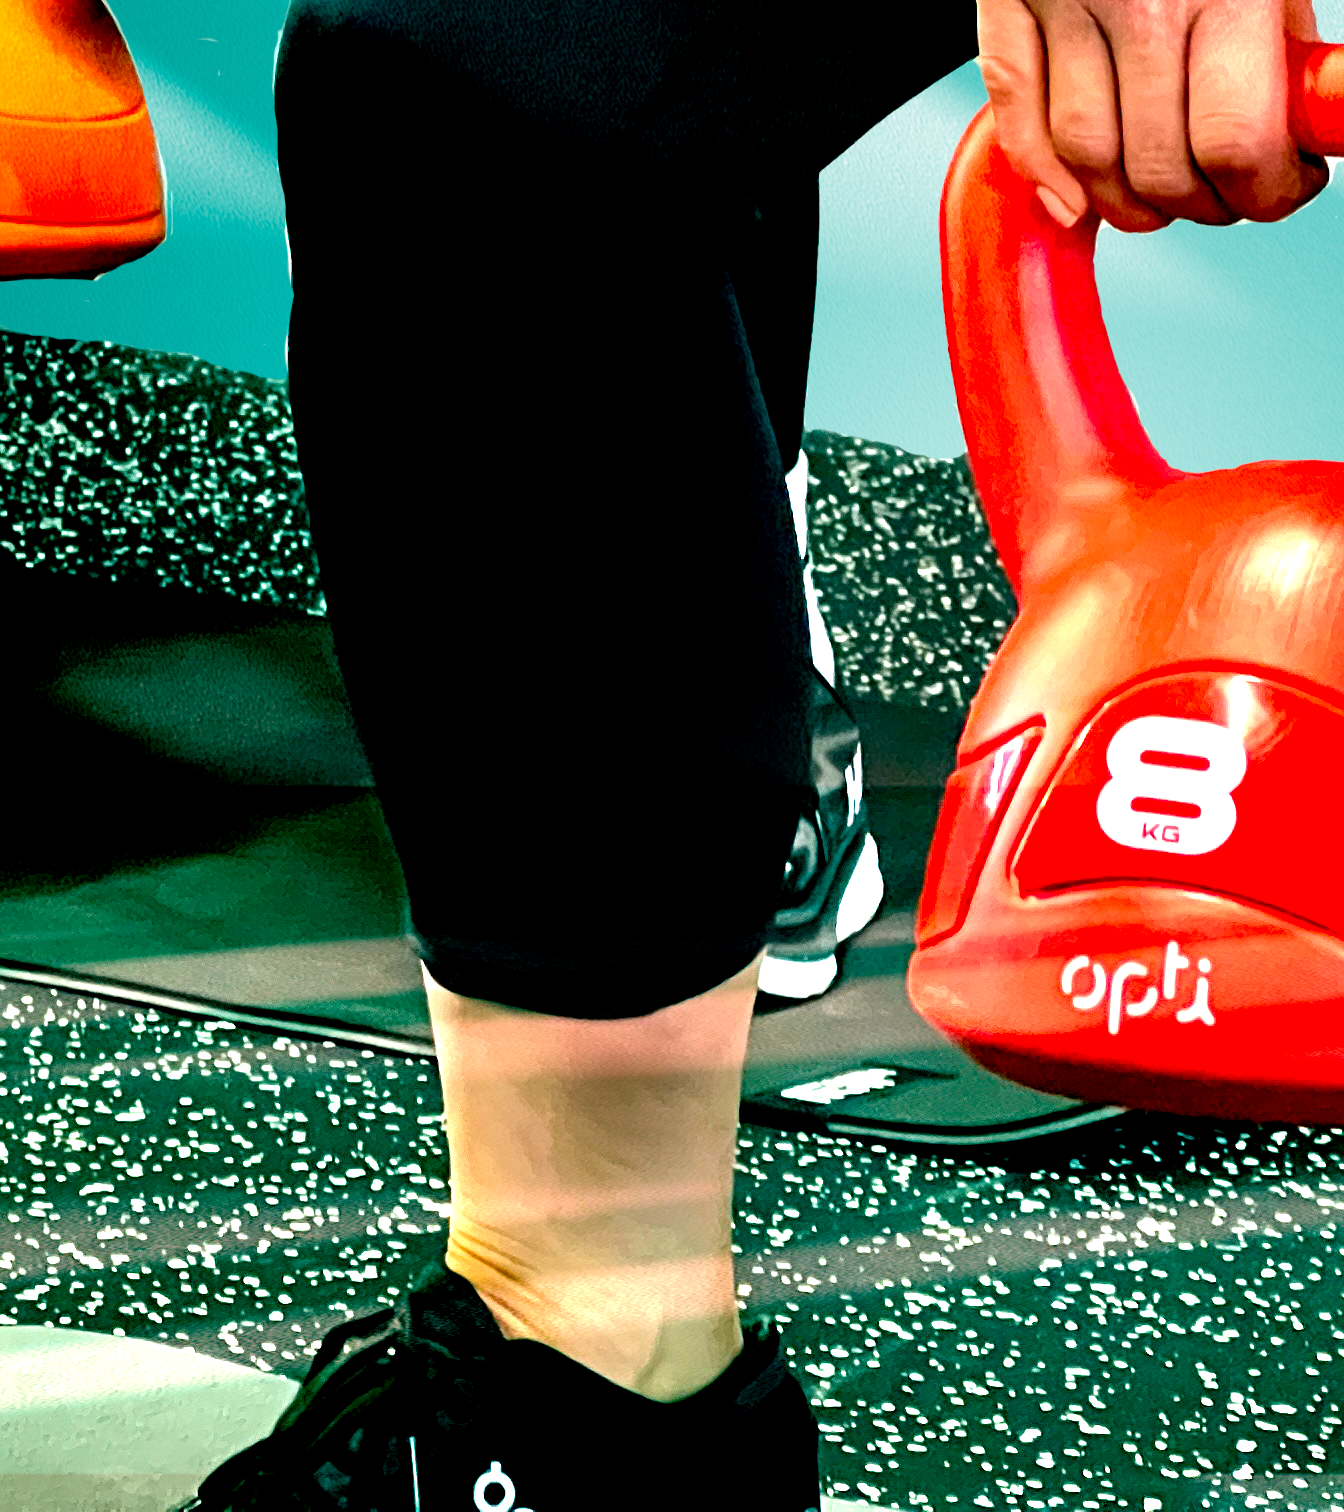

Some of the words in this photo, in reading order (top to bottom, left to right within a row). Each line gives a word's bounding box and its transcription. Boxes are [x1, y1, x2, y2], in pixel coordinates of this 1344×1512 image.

[1096, 714, 1248, 856] 8
[1141, 822, 1181, 844] KG
[1061, 940, 1216, 1035] opti
